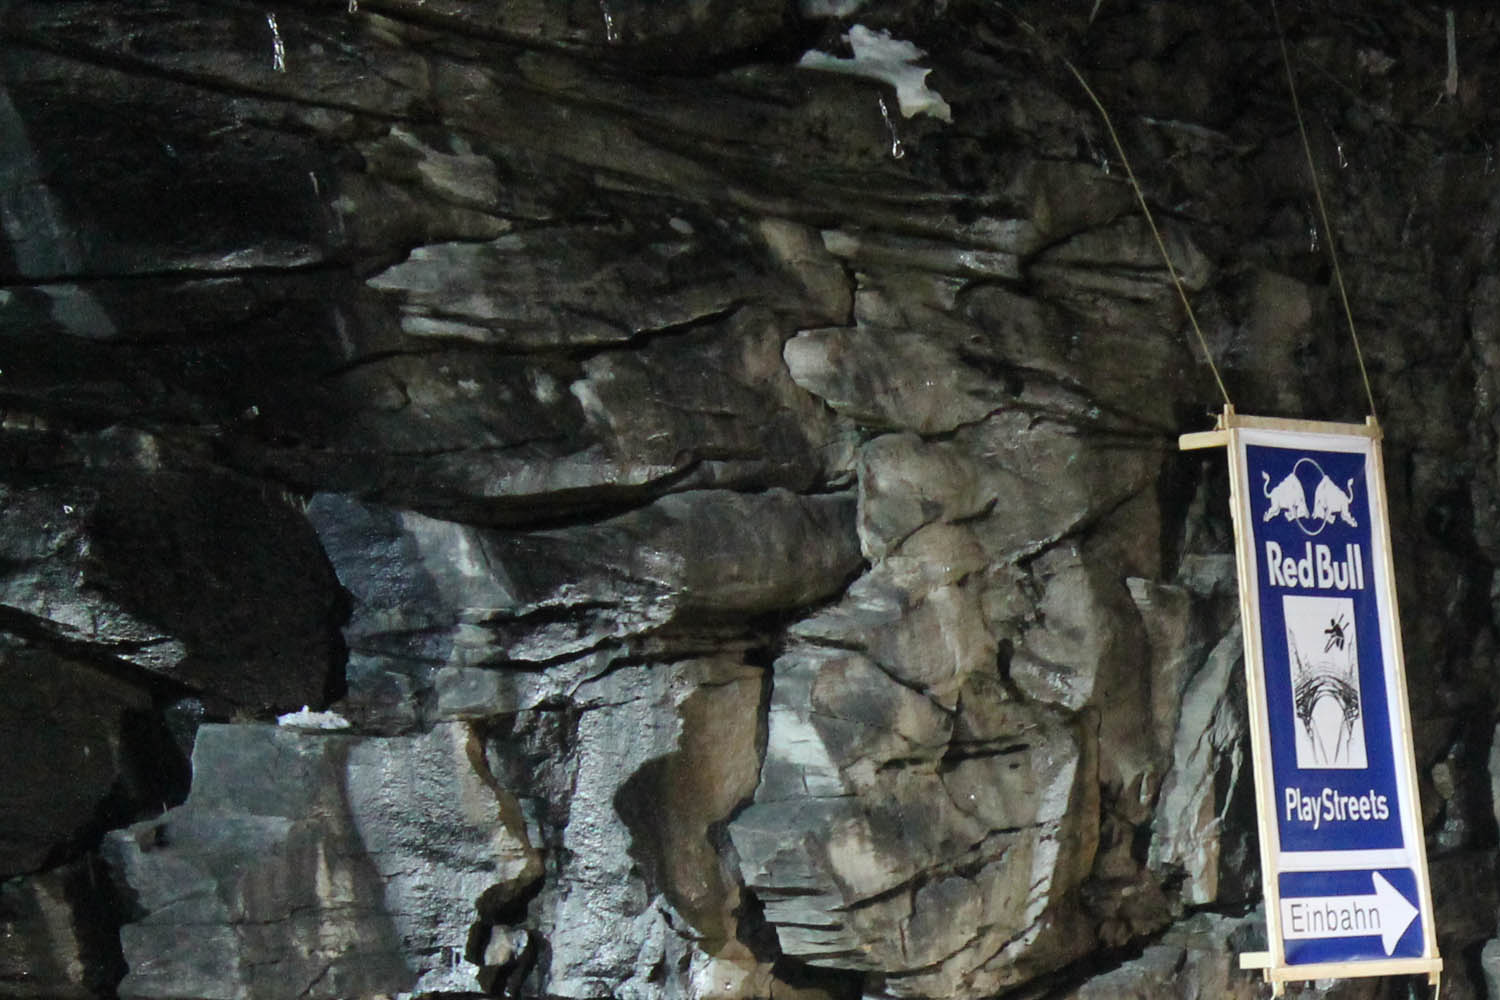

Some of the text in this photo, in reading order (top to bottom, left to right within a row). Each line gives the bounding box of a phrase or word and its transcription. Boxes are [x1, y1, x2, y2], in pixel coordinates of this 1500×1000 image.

[1265, 541, 1364, 591] Red Bull
[1291, 901, 1381, 932] Einbahn
